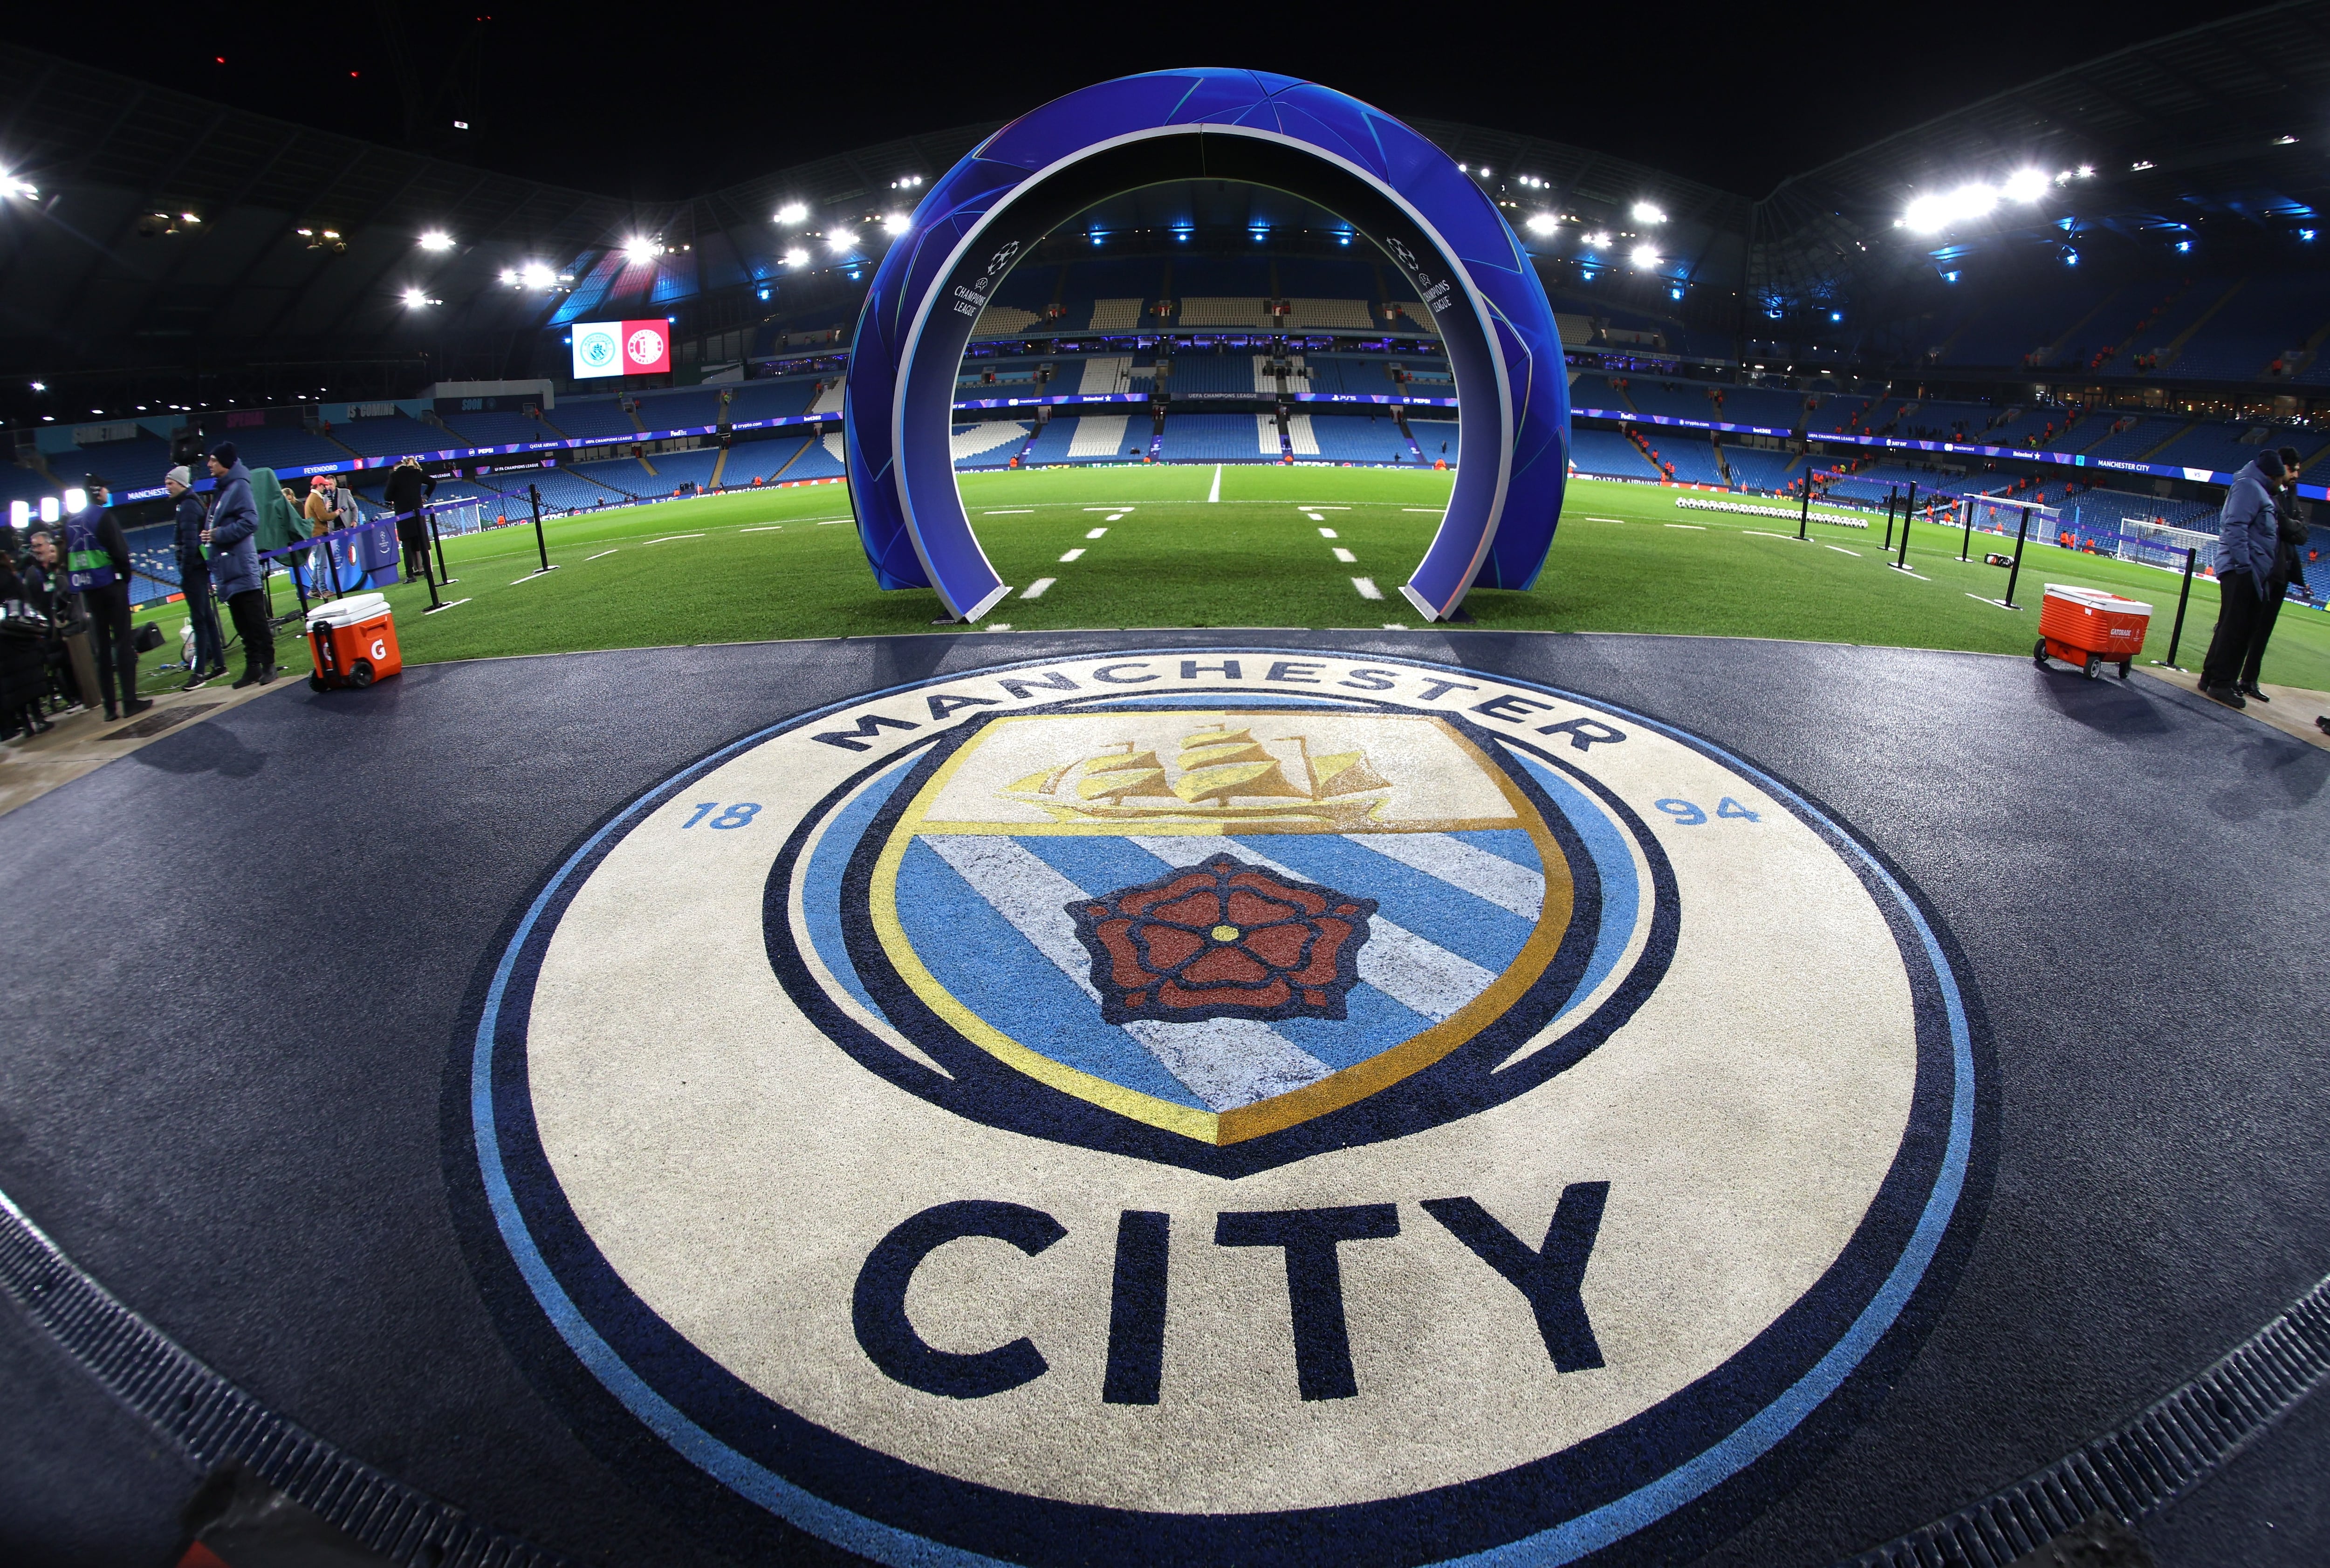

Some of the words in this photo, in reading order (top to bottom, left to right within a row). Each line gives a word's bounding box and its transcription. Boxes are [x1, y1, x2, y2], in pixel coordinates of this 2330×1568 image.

[954, 285, 986, 306] CHAMPIONS
[1423, 280, 1450, 302] CHAMPIONS
[953, 301, 976, 317] LEAGUE
[1432, 296, 1452, 313] LEAGUE
[347, 405, 356, 418] IS
[360, 403, 395, 417] COMING
[462, 398, 482, 411] SOON
[304, 465, 338, 474] FEYENOORD
[2098, 459, 2136, 470] MANCHESTER
[2136, 464, 2150, 472] CITY
[2110, 628, 2132, 637] GATORADE
[371, 638, 387, 660] G
[811, 660, 1627, 752] MANCHESTER
[682, 802, 762, 830] 18
[1654, 796, 1762, 825] 94
[851, 1181, 1611, 1405] CITY
